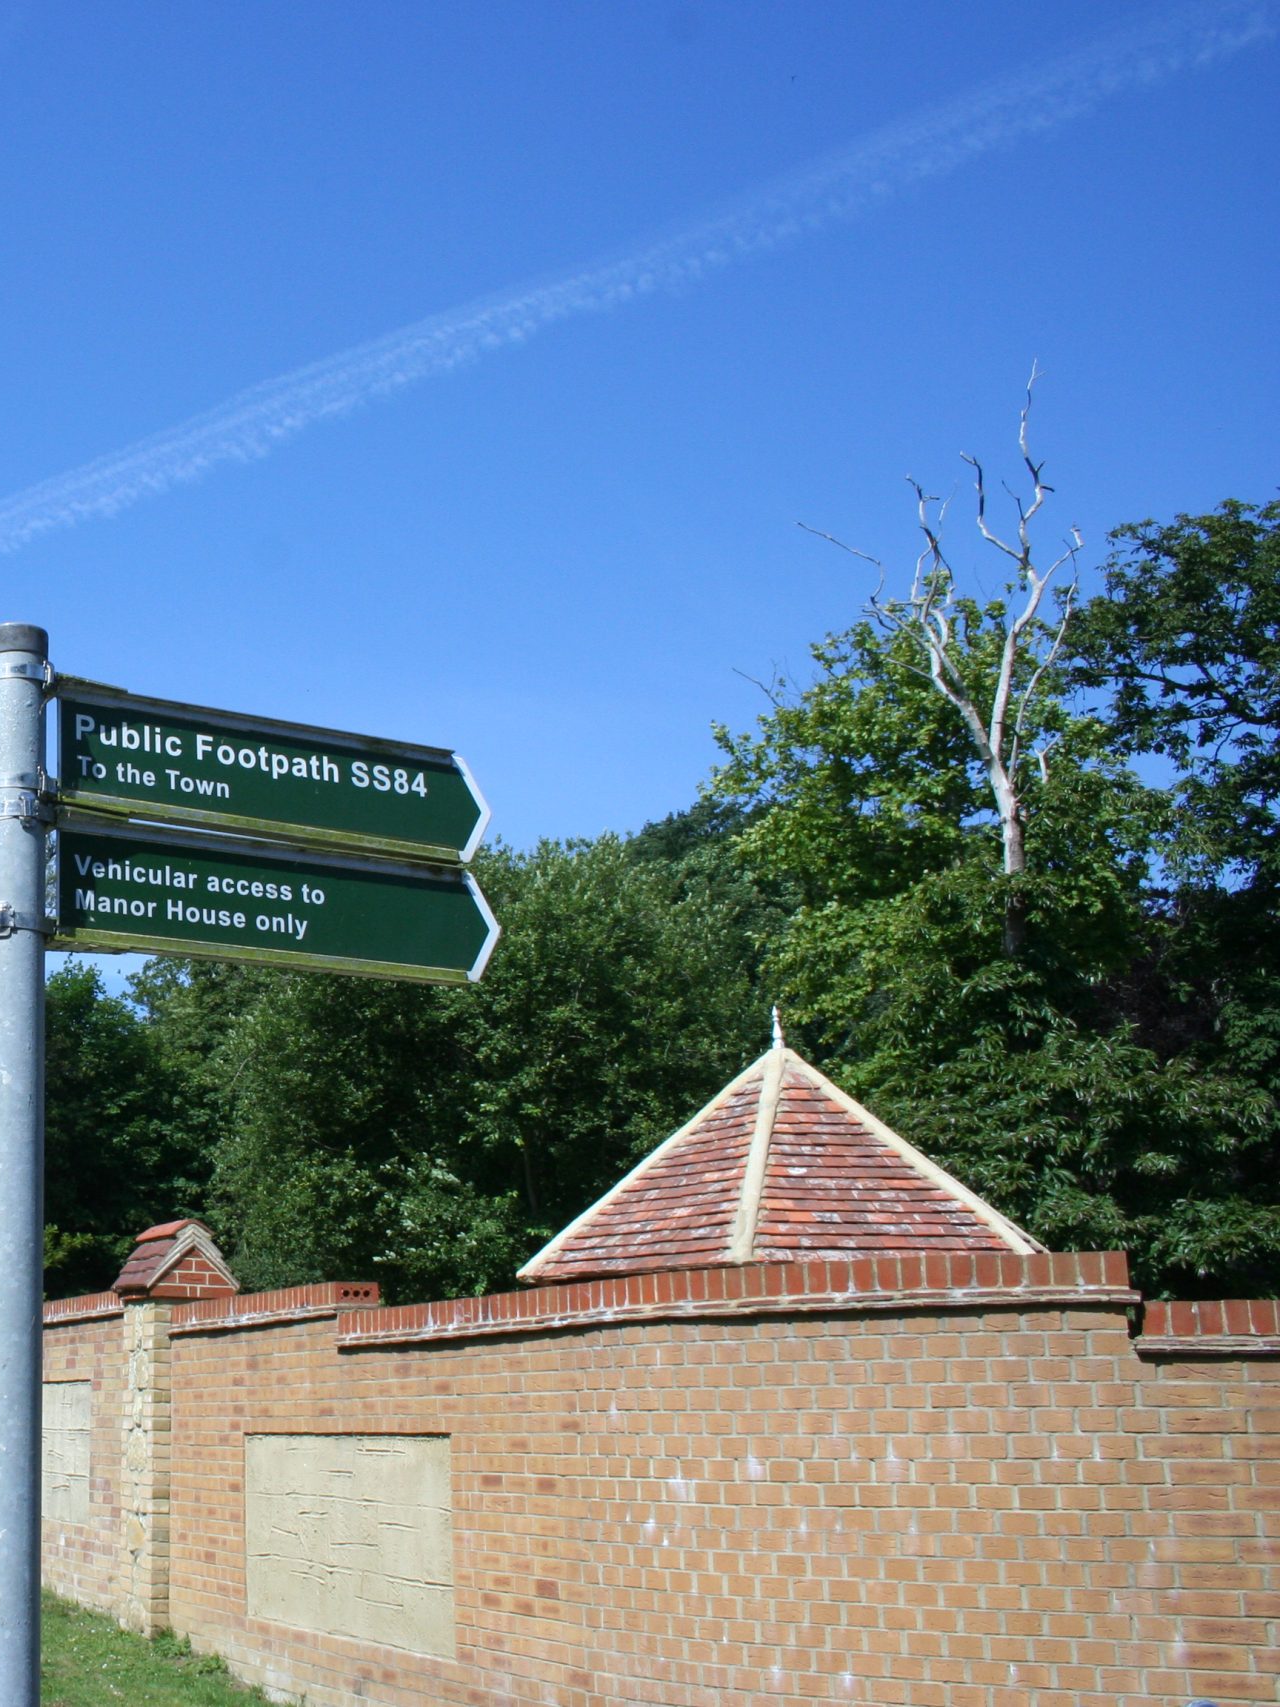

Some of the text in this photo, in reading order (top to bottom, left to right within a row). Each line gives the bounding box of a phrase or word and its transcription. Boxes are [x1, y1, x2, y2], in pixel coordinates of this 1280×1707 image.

[75, 714, 427, 797] Public Footpath SS84
[77, 756, 230, 798] To the Town
[74, 854, 325, 905] Vehicular access to
[75, 889, 308, 940] Manor House only
